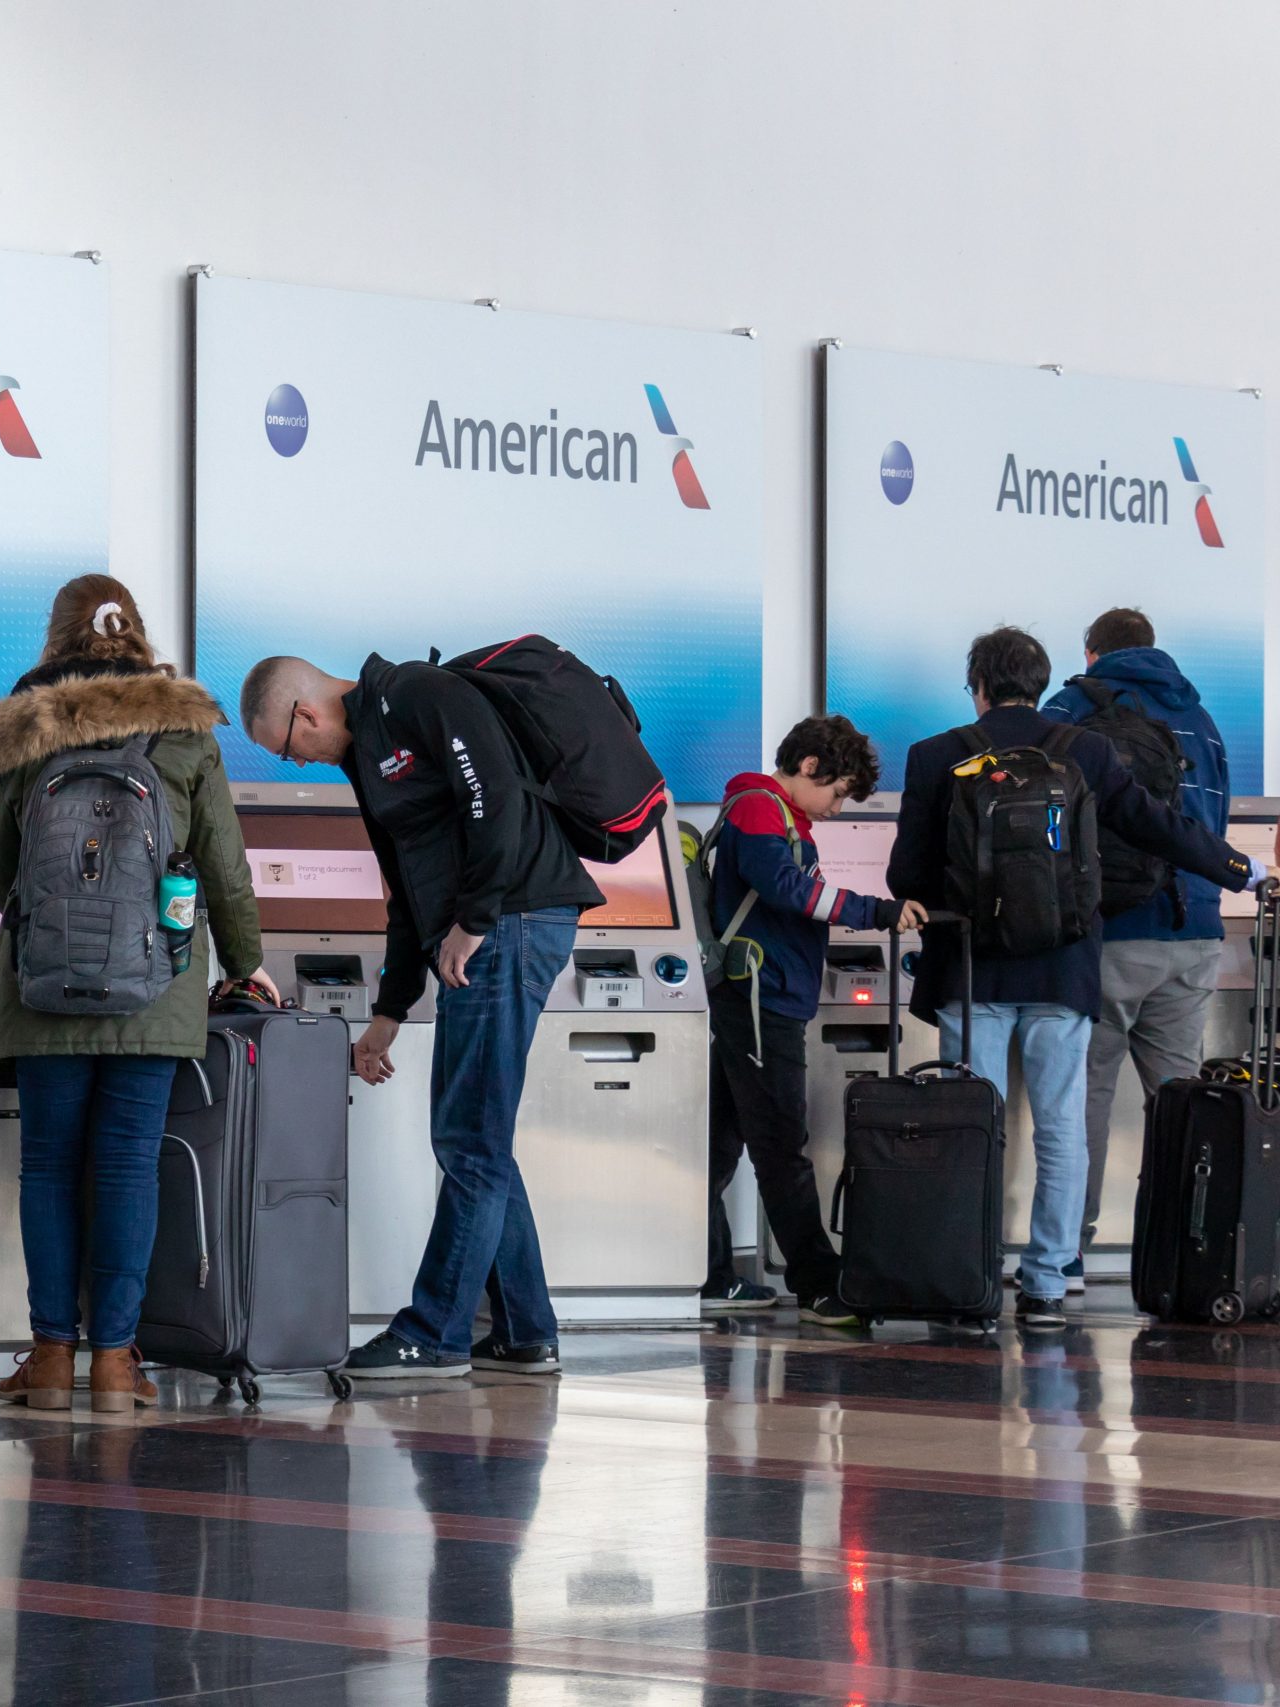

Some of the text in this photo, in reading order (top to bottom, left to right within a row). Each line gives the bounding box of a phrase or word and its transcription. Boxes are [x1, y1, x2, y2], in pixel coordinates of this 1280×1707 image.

[266, 413, 307, 429] oneworld
[415, 400, 637, 484] American
[881, 467, 913, 480] oneworld
[996, 453, 1168, 525] American
[457, 753, 484, 819] FINISHER
[298, 864, 326, 874] Printing
